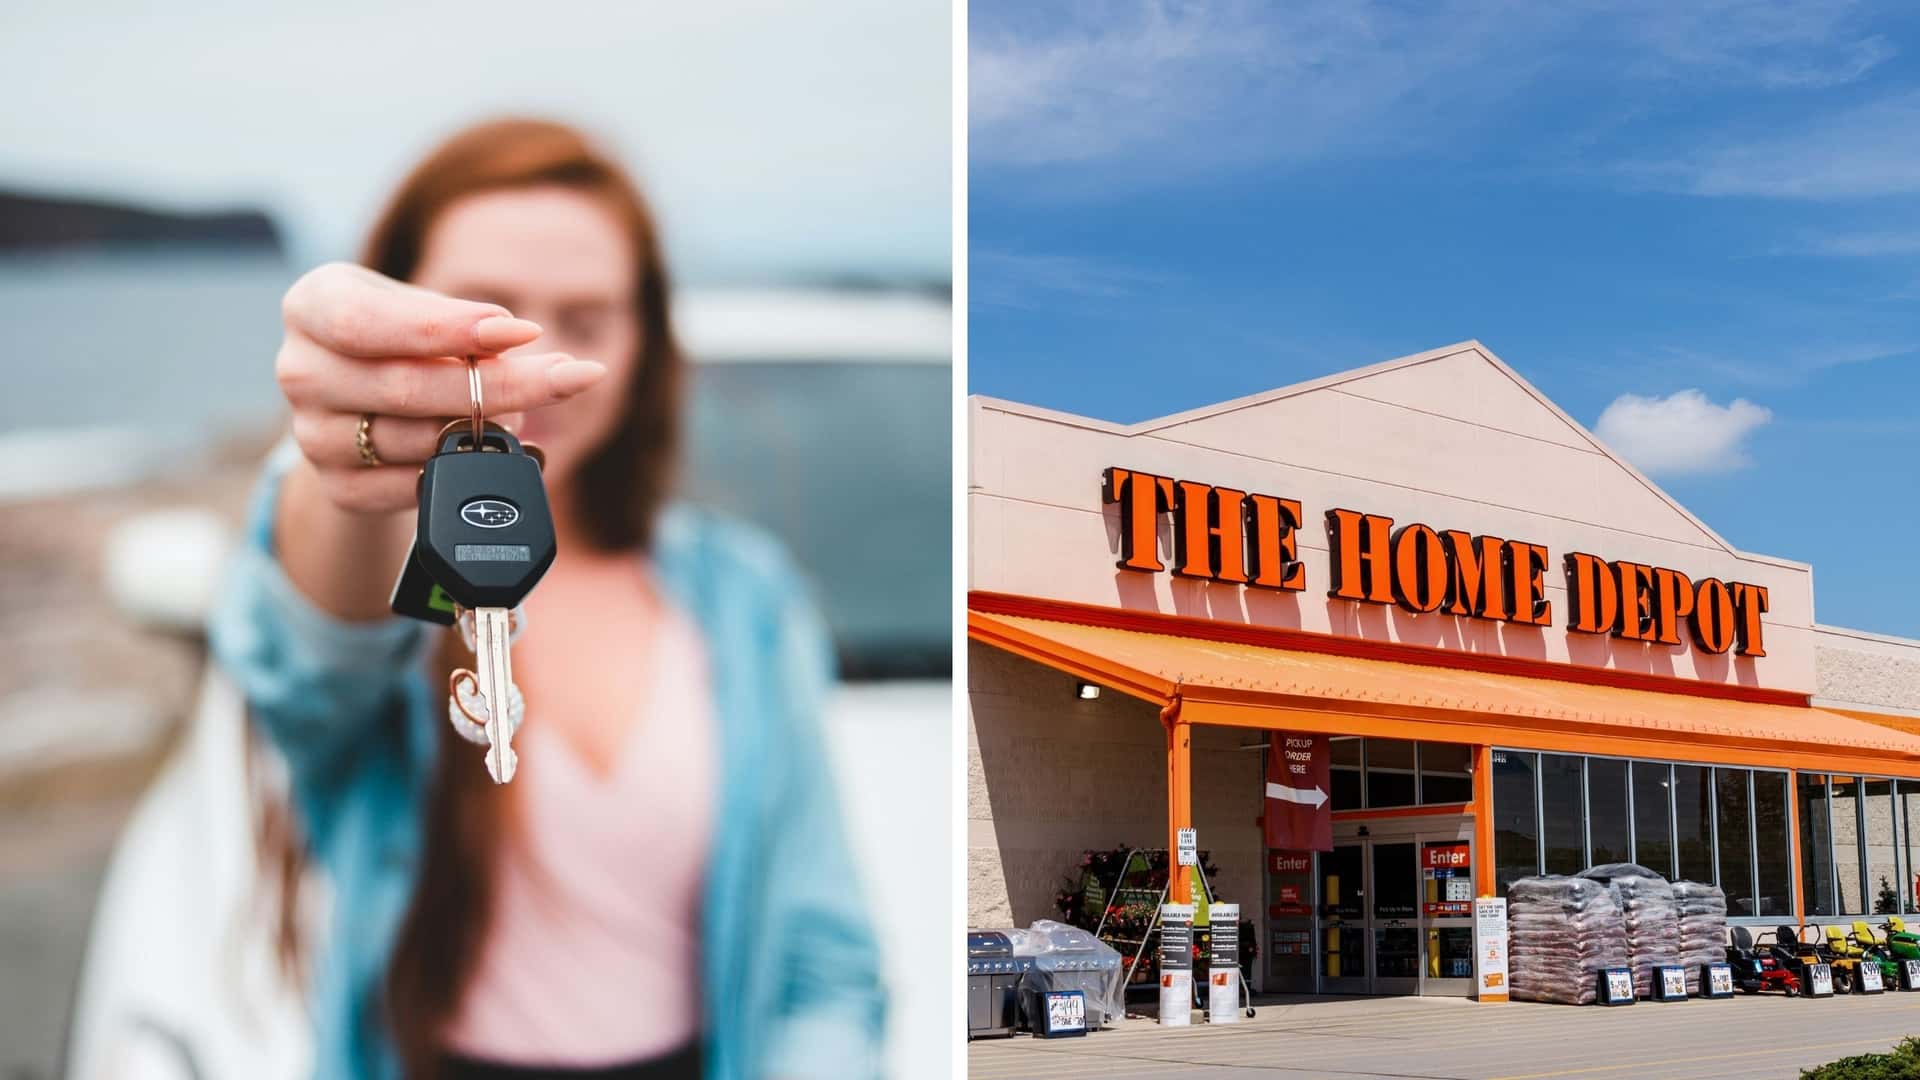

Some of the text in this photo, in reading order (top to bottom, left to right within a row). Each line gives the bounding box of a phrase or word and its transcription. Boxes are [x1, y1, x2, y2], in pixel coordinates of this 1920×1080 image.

[1102, 466, 1768, 658] THE HOME DEPOT
[1284, 750, 1312, 761] ORDER
[1276, 856, 1308, 870] Enter
[1429, 849, 1466, 865] Enter
